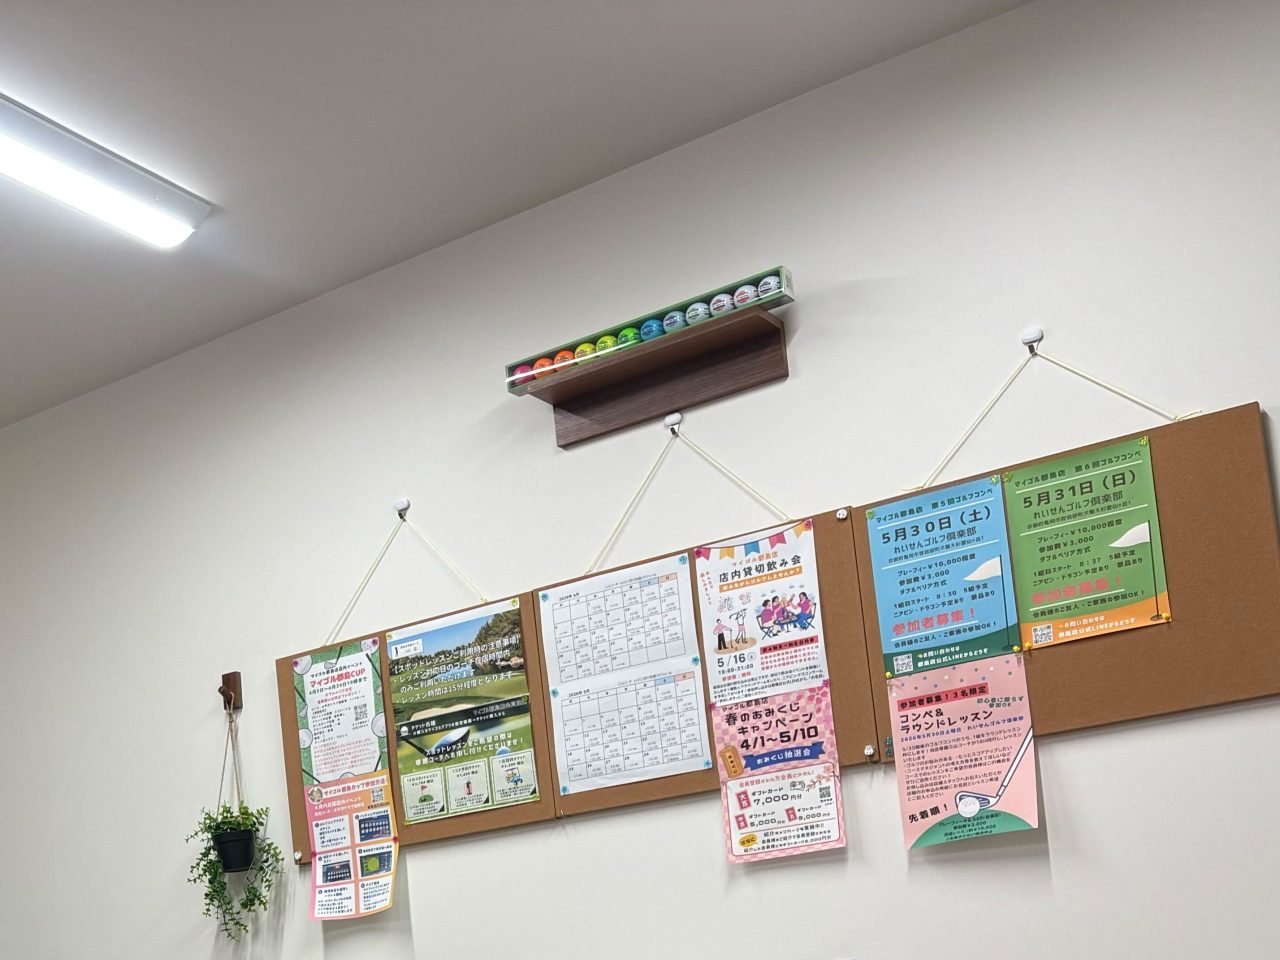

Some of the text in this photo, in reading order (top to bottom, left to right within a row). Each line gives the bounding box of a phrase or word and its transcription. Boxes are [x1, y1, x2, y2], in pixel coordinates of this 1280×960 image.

[876, 505, 923, 523] マイゴル都島店
[1033, 489, 1123, 521] れいせんゴルフ倶楽部
[881, 505, 992, 545] 5月30日（土）
[893, 526, 976, 554] れいせんゴルフ倶楽部
[719, 554, 801, 583] 店内貸切飲み会
[724, 700, 800, 726] 春のおみくじ
[737, 712, 813, 735] キャンペーン
[900, 709, 993, 735] ラウンドレッスン
[756, 747, 810, 764] おみくじ抽選会
[751, 787, 783, 796] ギフトカード
